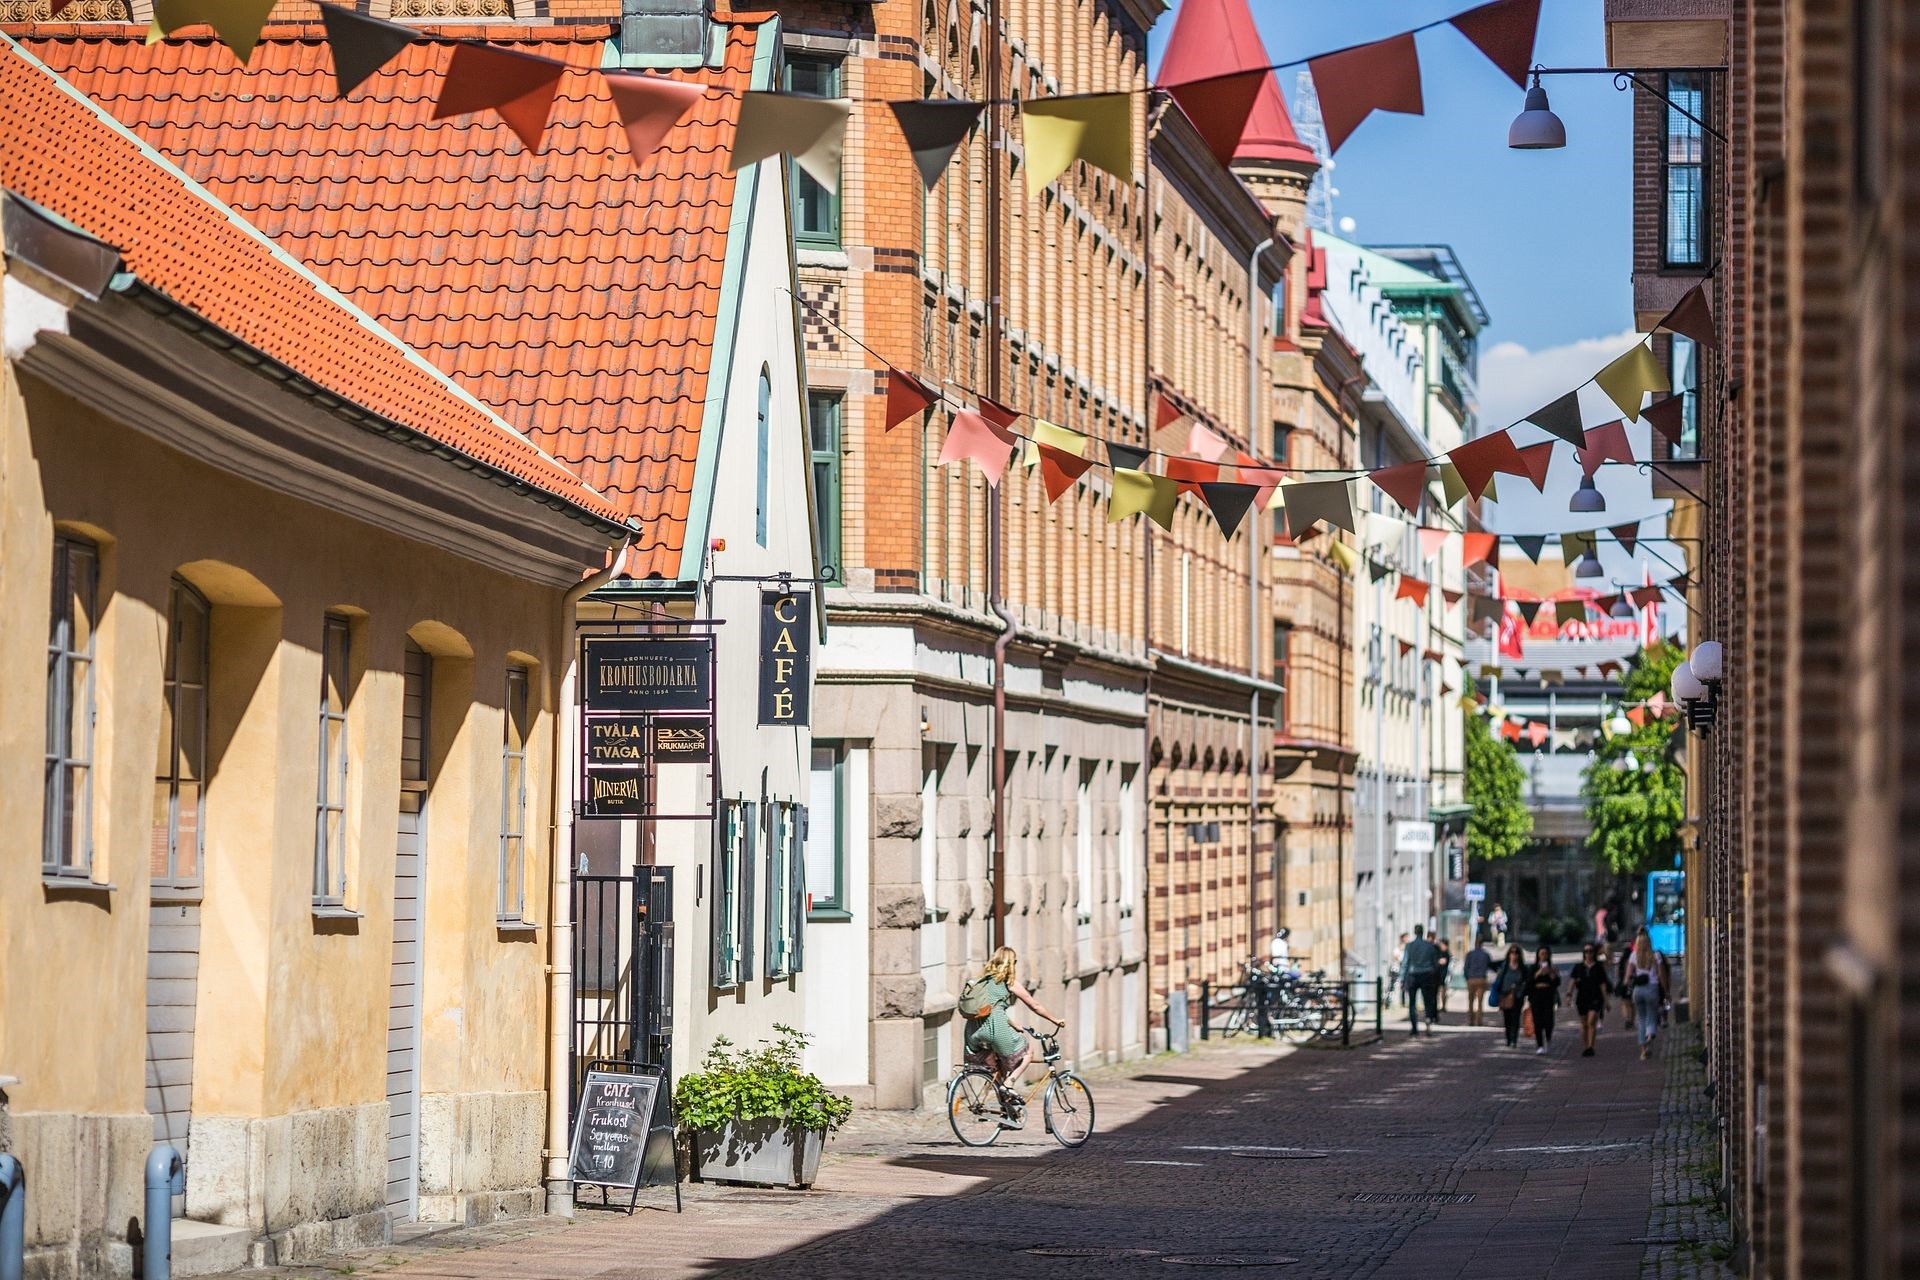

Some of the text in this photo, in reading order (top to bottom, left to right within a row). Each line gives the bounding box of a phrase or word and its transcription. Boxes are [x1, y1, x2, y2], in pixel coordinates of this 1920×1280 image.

[772, 597, 797, 719] CAFÉ
[600, 666, 697, 686] KRONHUSBODARNA
[593, 723, 640, 737] TVÅLA
[593, 746, 640, 758] TVAGA
[593, 777, 639, 800] MINERVA
[591, 1114, 628, 1128] Frukost
[593, 1142, 620, 1152] mellan
